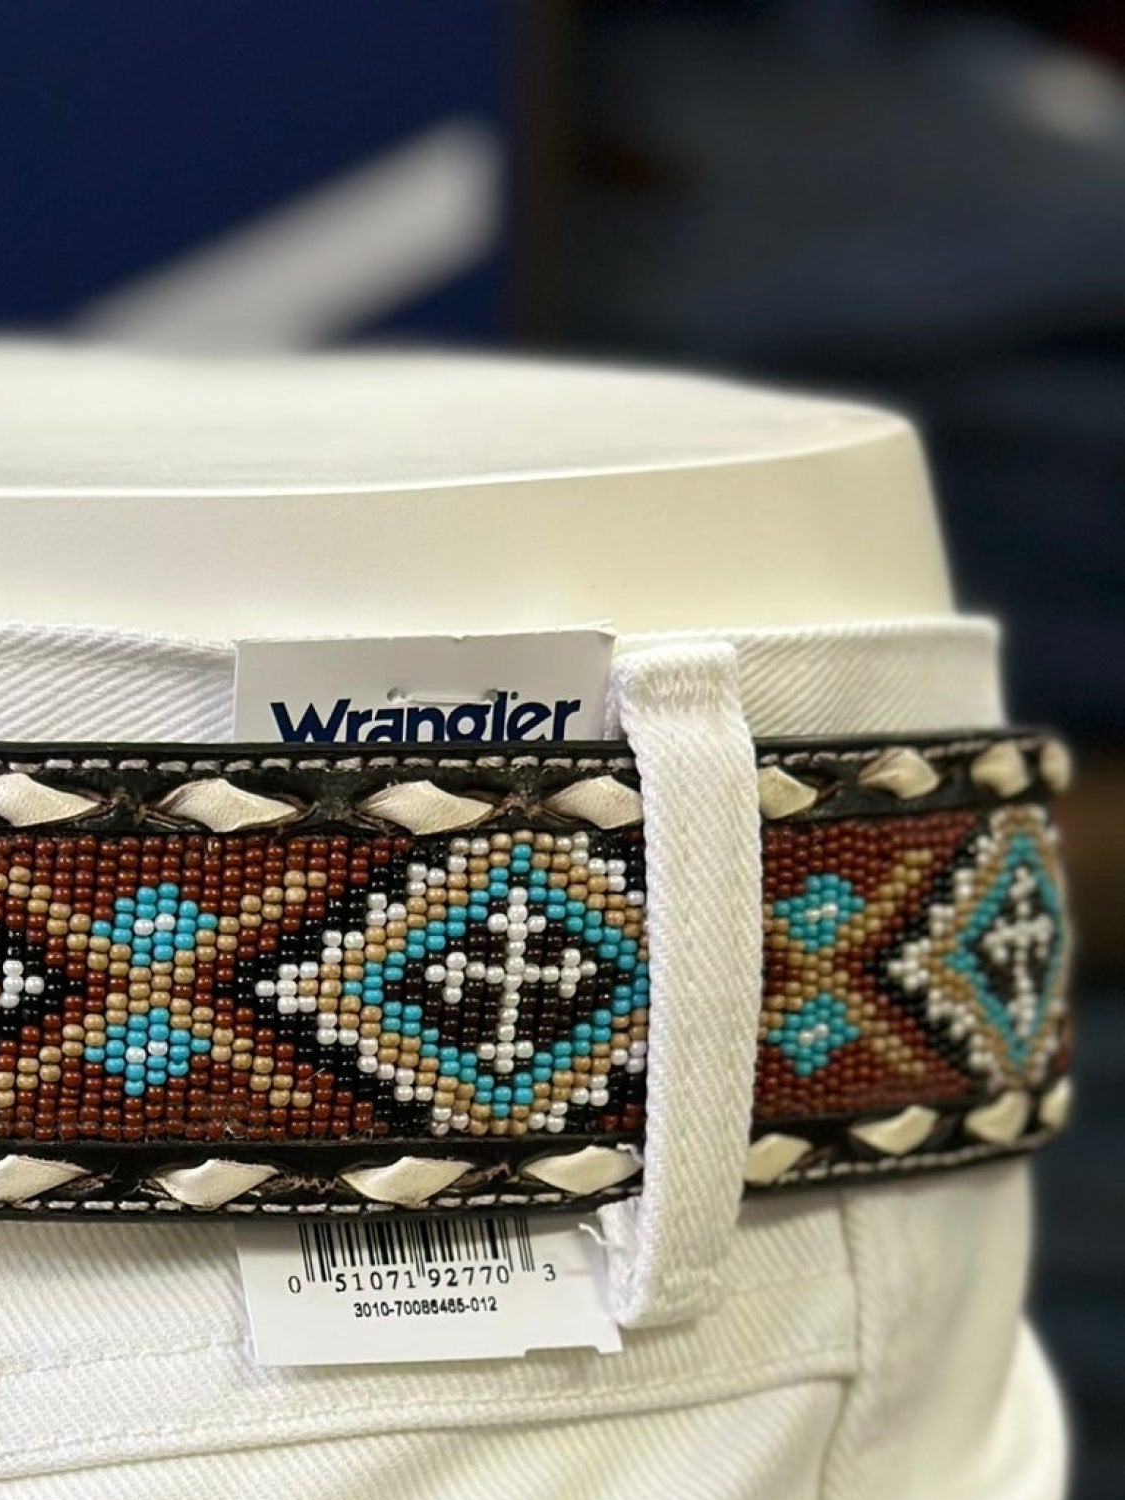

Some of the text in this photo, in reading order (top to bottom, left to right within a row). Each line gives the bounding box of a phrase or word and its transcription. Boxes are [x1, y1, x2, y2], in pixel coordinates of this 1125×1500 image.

[271, 691, 580, 742] Wrangler
[335, 1271, 416, 1292] 51071
[428, 1266, 510, 1287] 92770
